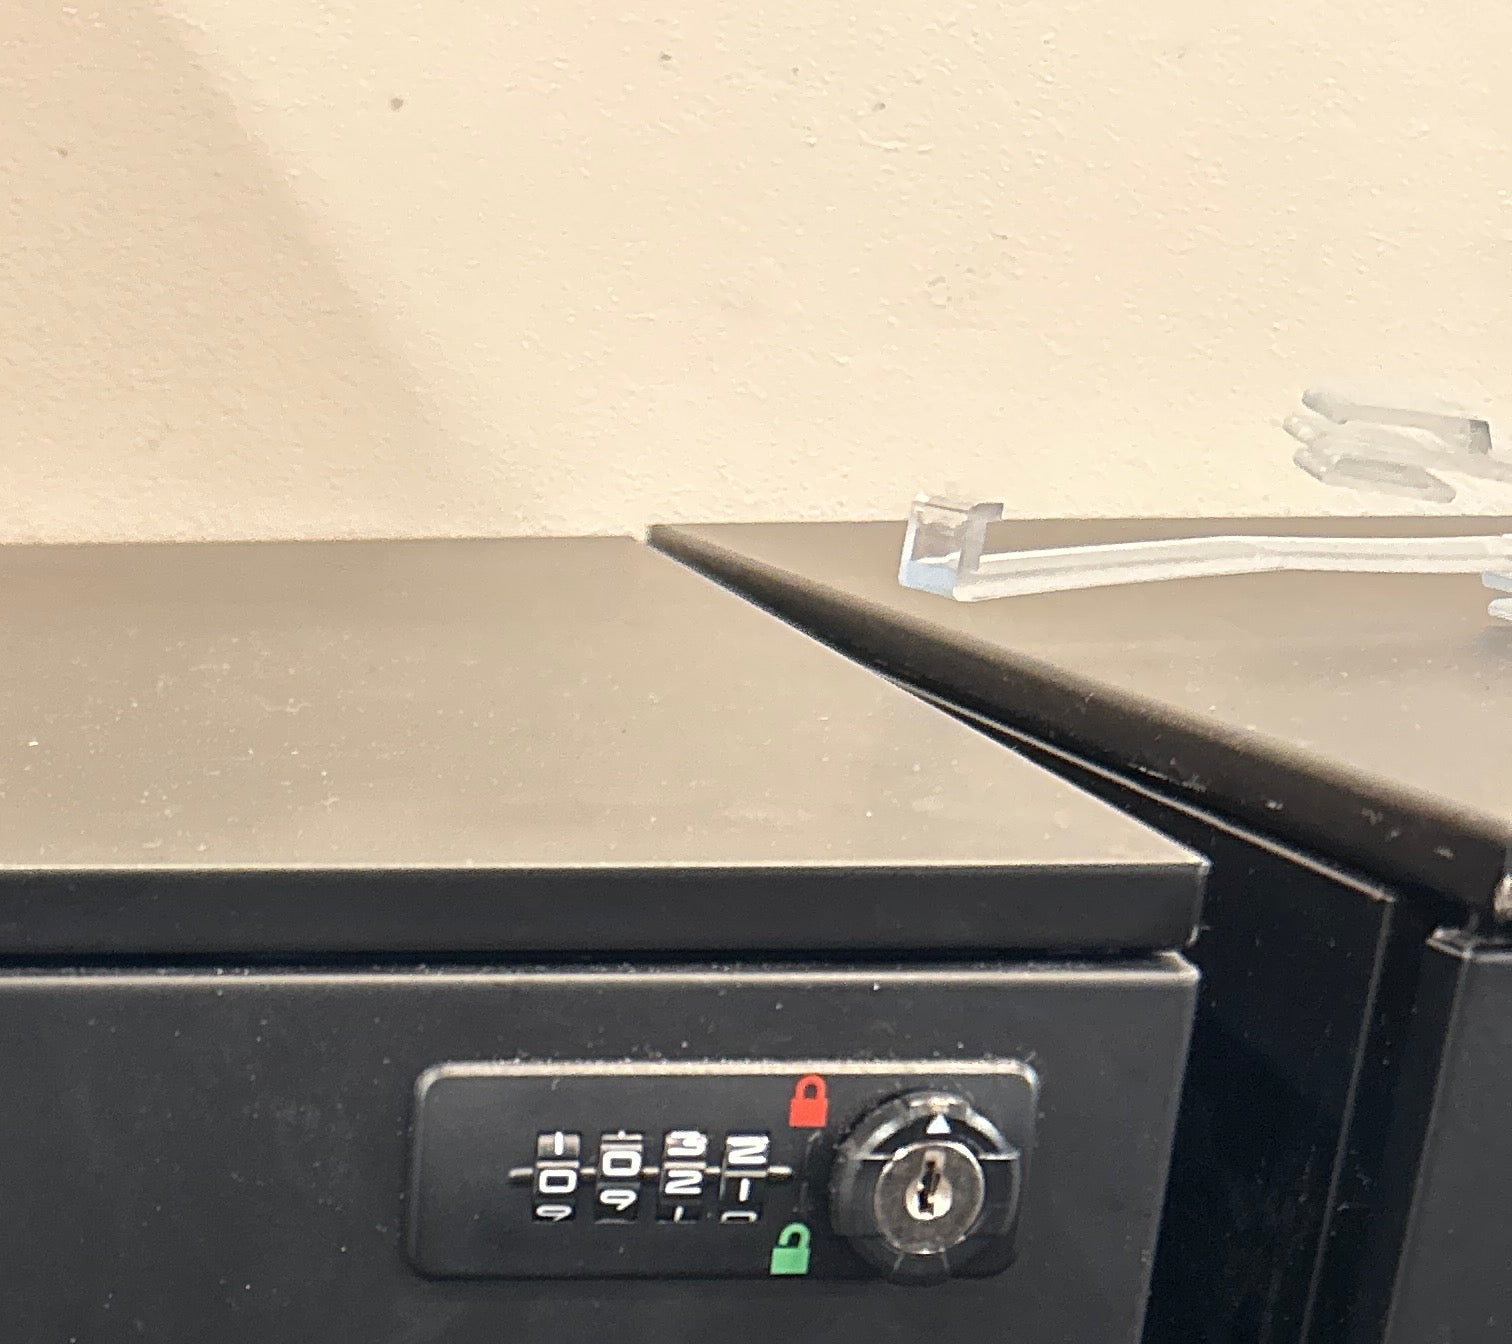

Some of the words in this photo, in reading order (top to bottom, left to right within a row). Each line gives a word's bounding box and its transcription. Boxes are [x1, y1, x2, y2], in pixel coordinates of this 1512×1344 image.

[553, 1131, 564, 1156] 1
[726, 1136, 769, 1165] 2
[538, 1169, 578, 1194] 0
[601, 1150, 642, 1177] 0
[664, 1170, 704, 1195] 2
[738, 1177, 751, 1202] 1
